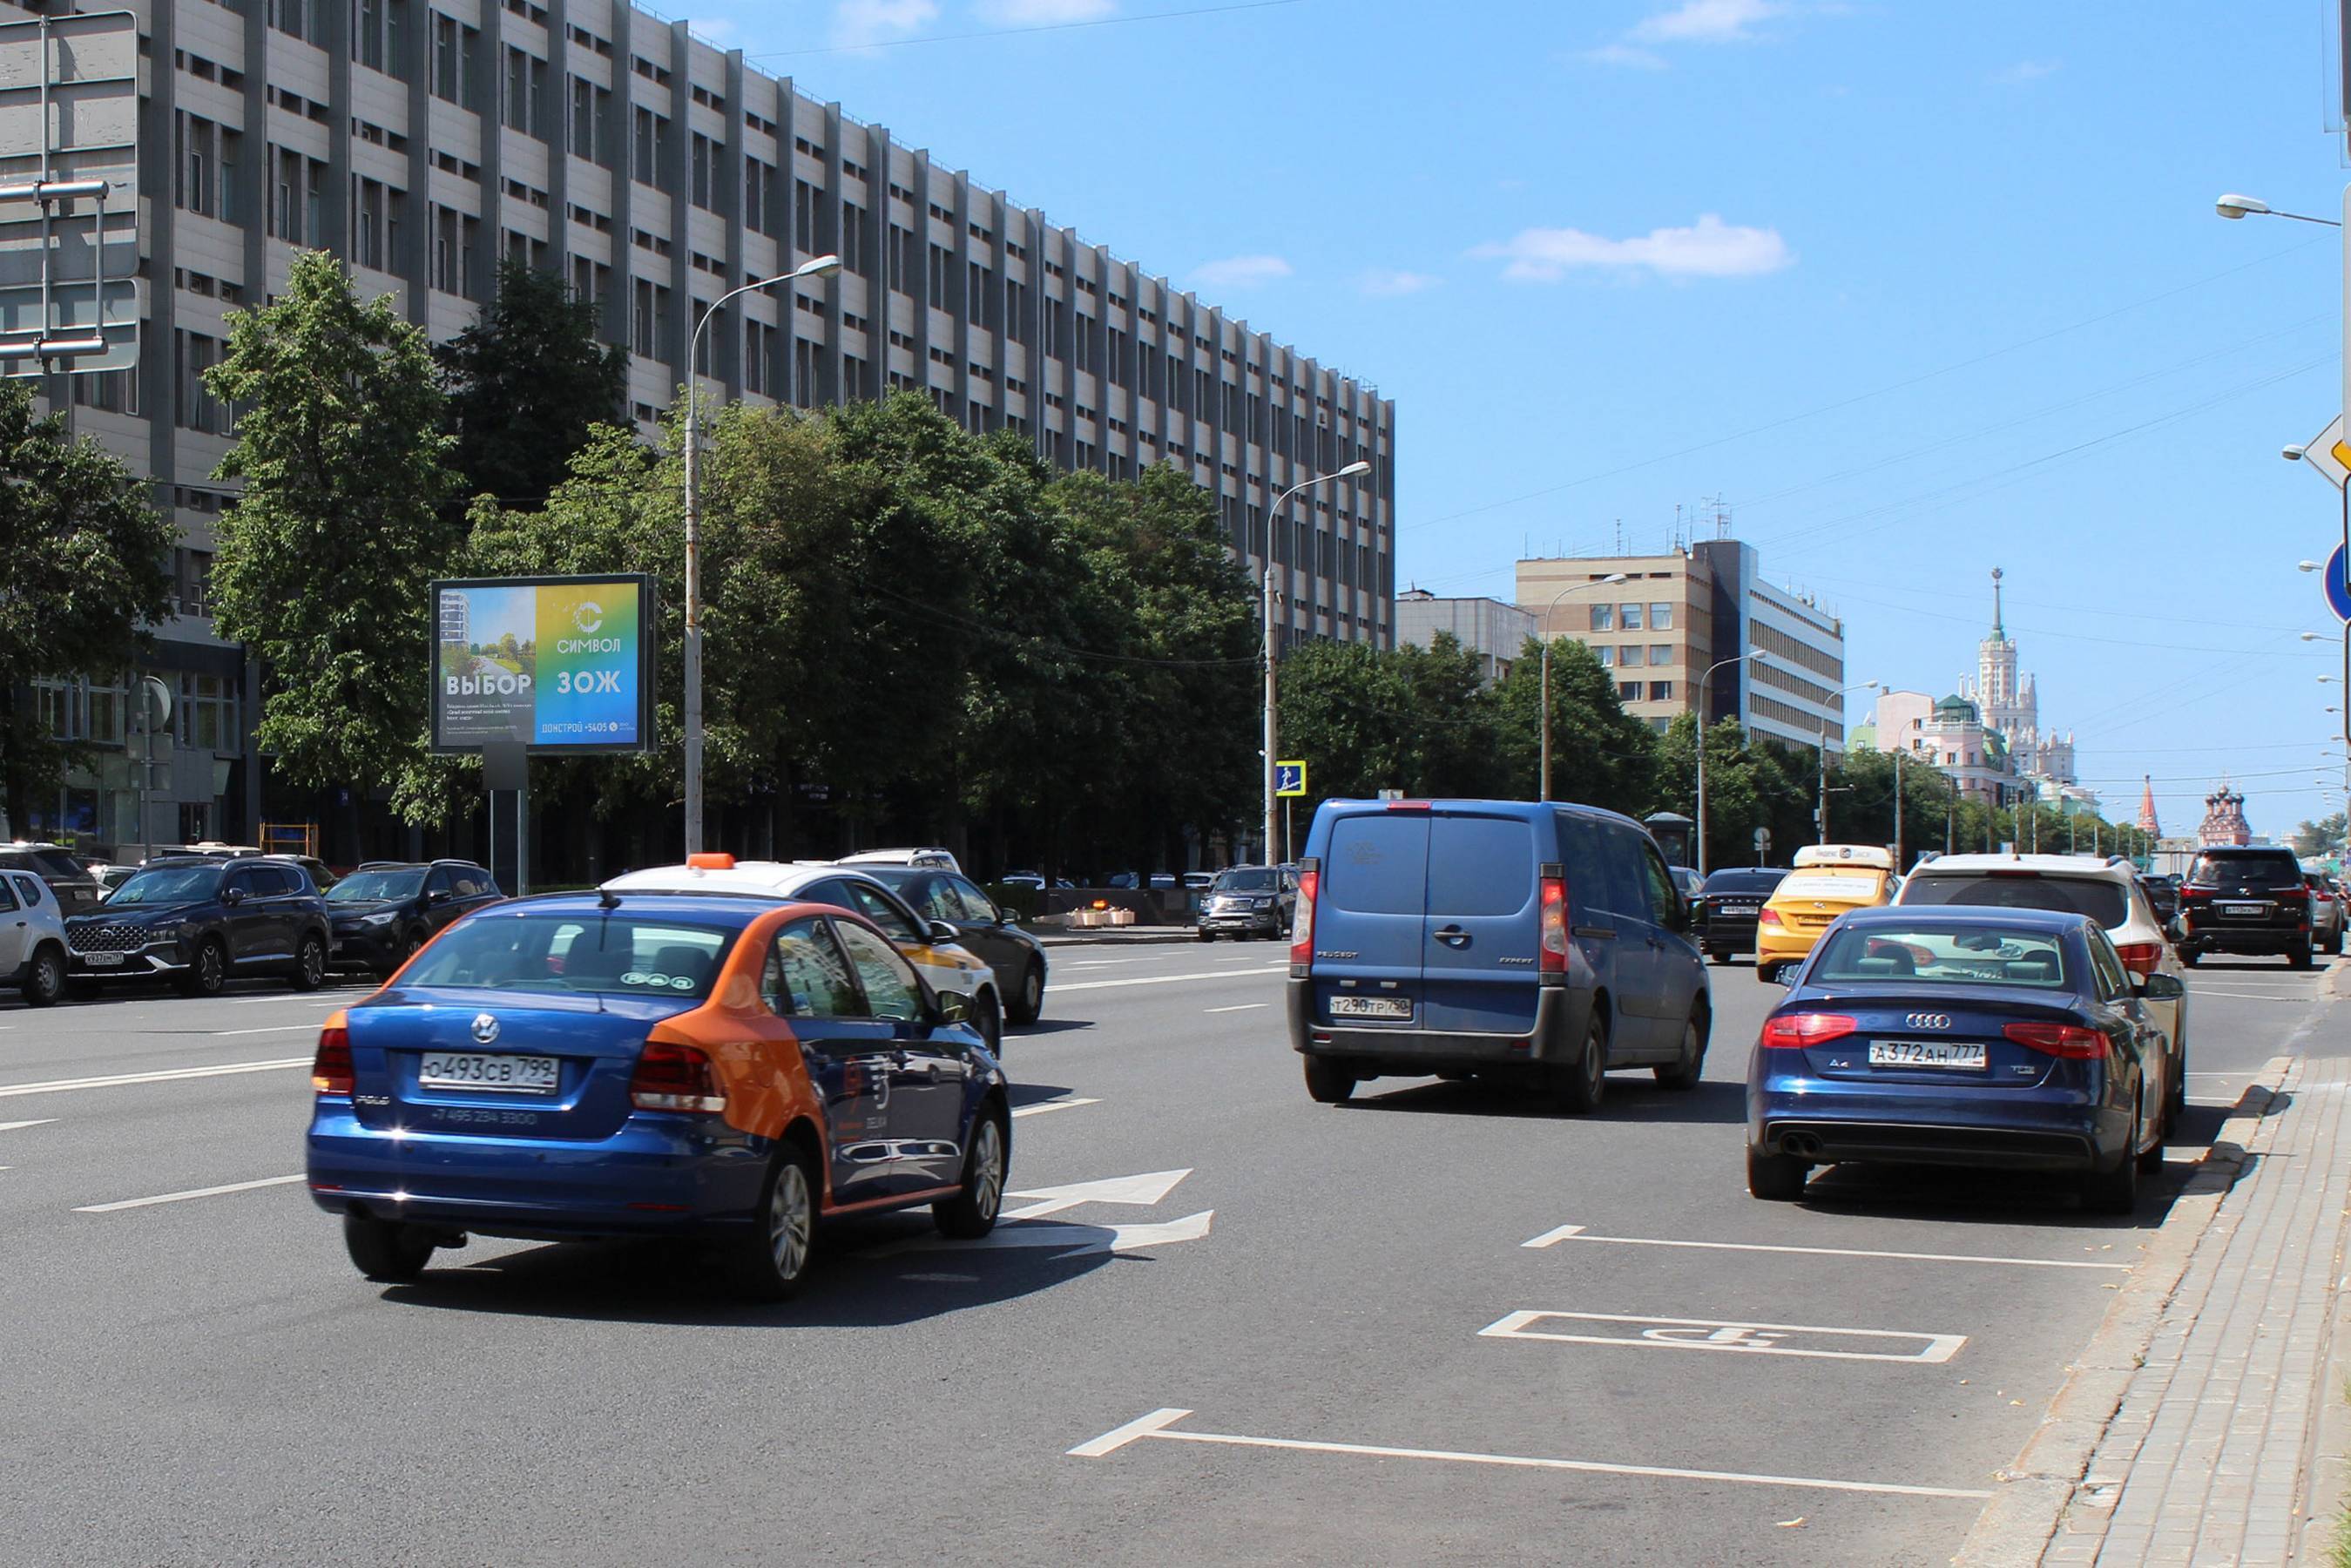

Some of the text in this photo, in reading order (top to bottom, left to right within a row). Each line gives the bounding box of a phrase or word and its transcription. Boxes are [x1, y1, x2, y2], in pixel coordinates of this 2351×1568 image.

[557, 639, 621, 654] СИМВОЛ
[446, 673, 531, 696] ВЫБОР
[557, 670, 622, 694] ЗОЖ
[542, 721, 583, 733] ДОНСТРОЙ
[1316, 950, 1359, 959] PEUGEOT
[1951, 1044, 1980, 1059] 777
[517, 1058, 552, 1078] 799
